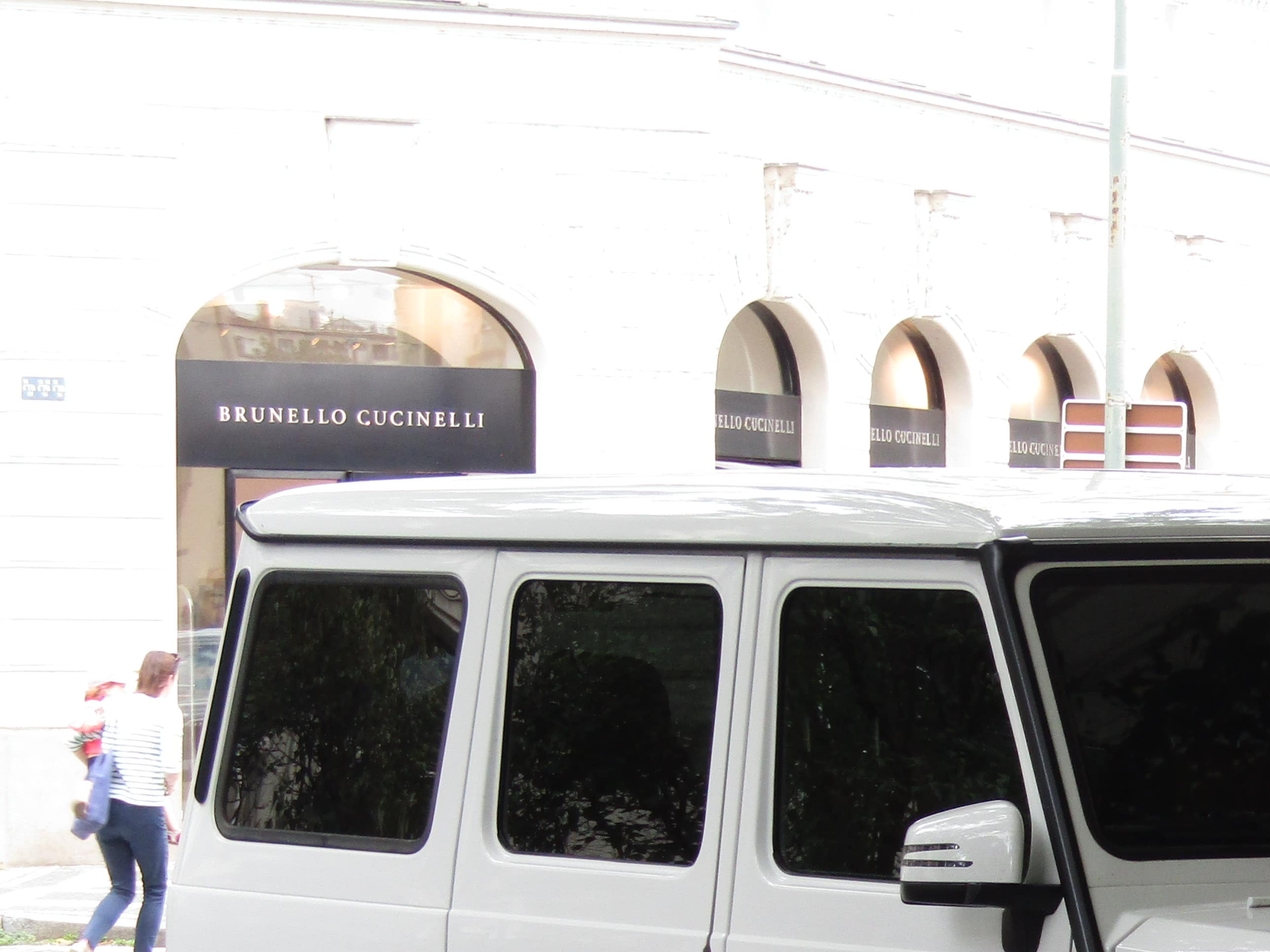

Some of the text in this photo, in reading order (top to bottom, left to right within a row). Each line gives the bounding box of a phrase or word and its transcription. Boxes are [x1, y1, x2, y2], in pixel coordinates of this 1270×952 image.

[218, 406, 485, 428] BRUNELLO CUCINELLI
[744, 416, 795, 435] CUCINELLI
[894, 429, 940, 447] CUCINELLI
